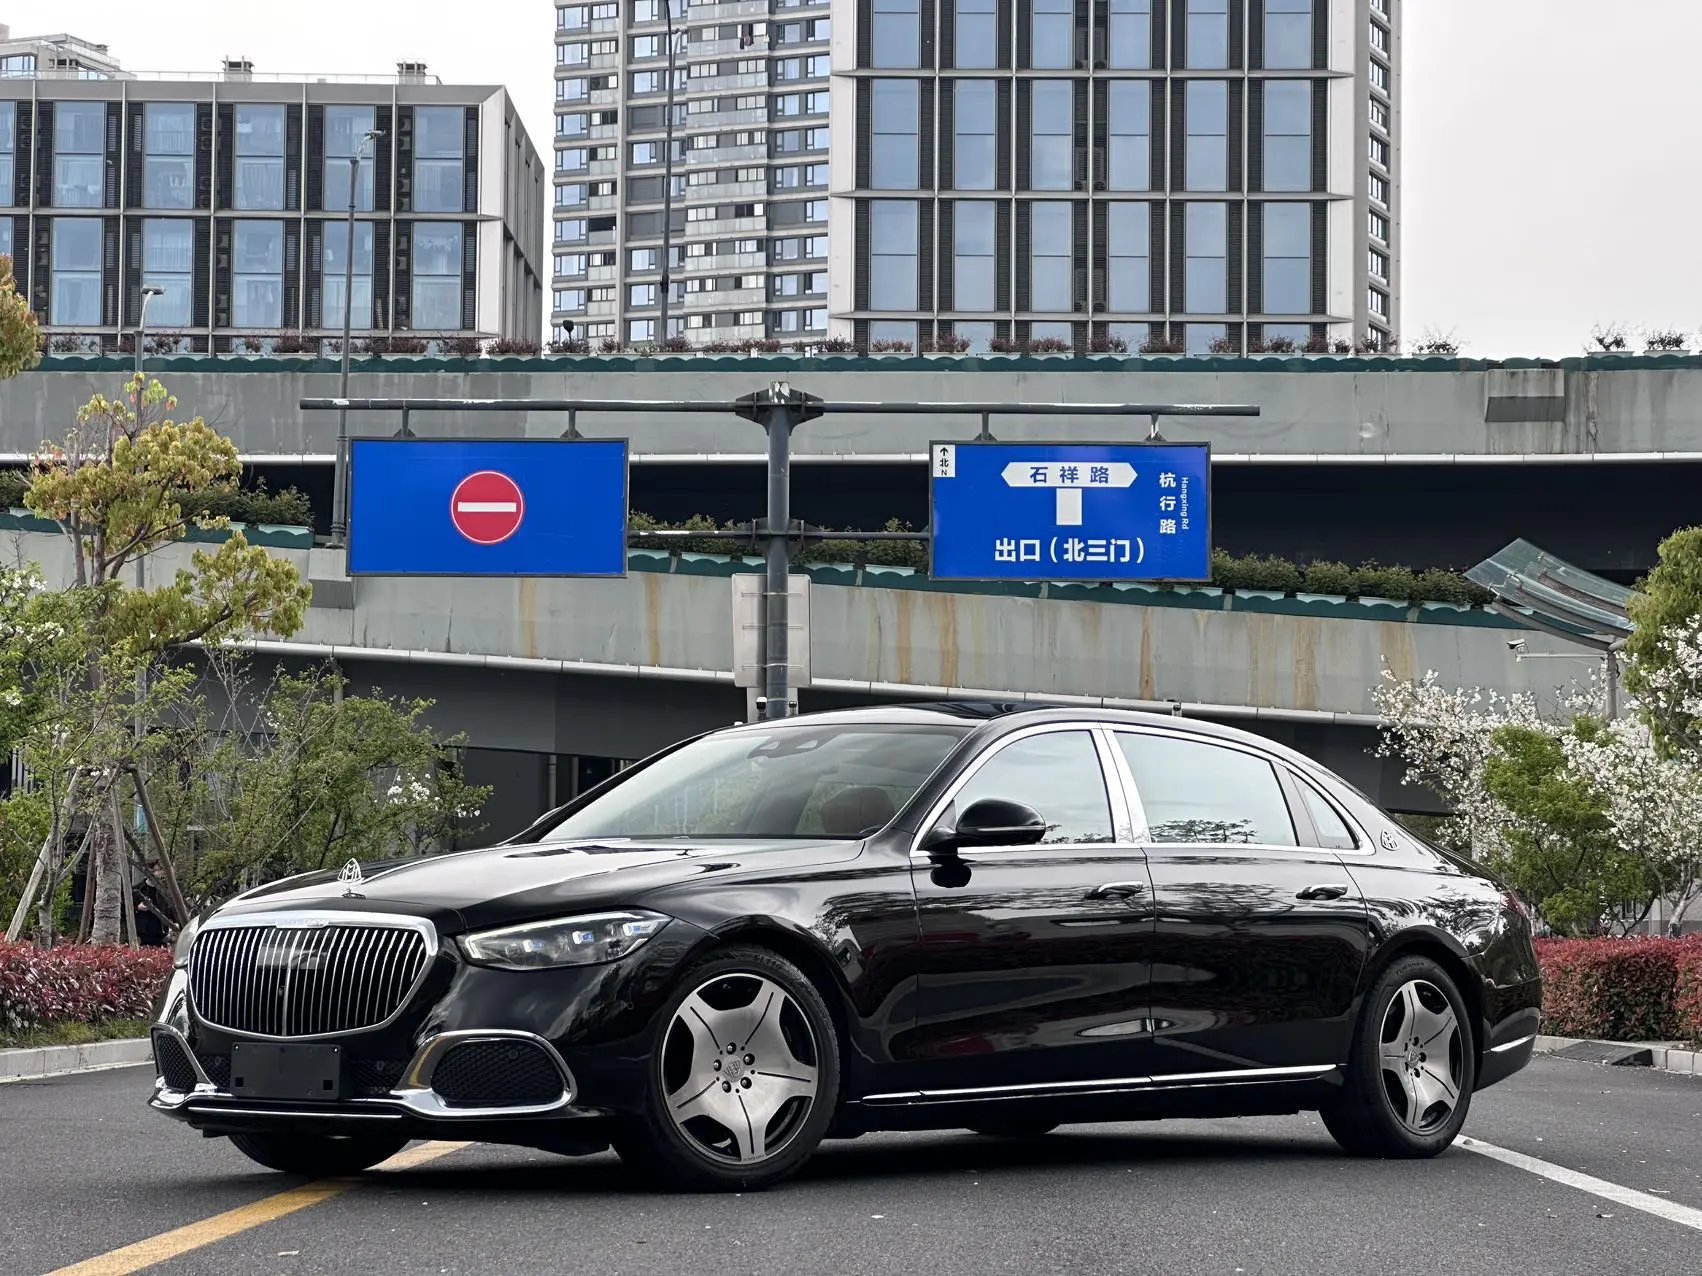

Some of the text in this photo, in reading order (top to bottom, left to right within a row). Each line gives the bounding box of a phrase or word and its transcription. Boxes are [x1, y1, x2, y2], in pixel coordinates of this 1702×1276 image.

[939, 457, 949, 468] 北
[1029, 465, 1109, 484] 石祥路
[1159, 472, 1177, 535] 杭行路
[1180, 477, 1190, 530] Hangxing Rd
